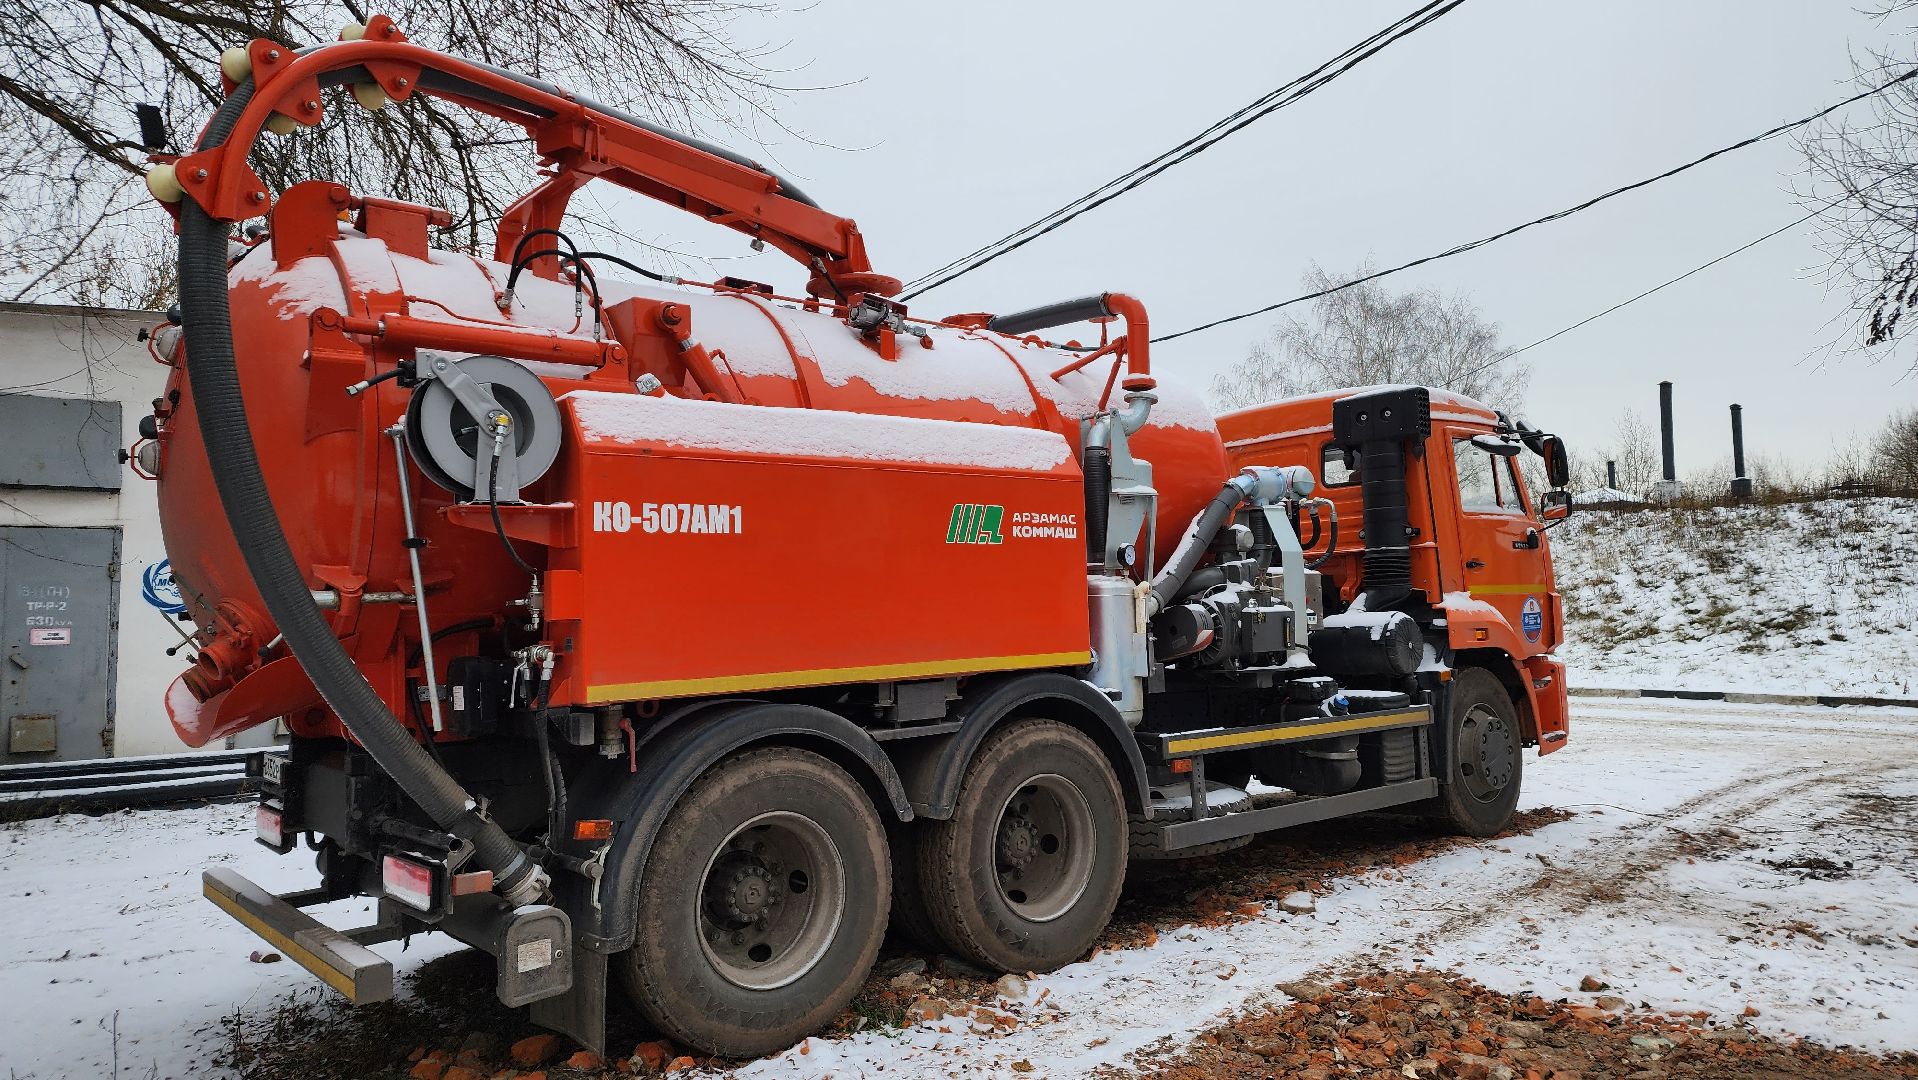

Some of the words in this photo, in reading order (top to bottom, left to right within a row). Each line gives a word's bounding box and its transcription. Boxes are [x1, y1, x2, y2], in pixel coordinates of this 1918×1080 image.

[593, 501, 742, 534] КО-507АМ1
[1012, 512, 1077, 525] АРЗАМАС
[1012, 525, 1077, 539] КОММАШ
